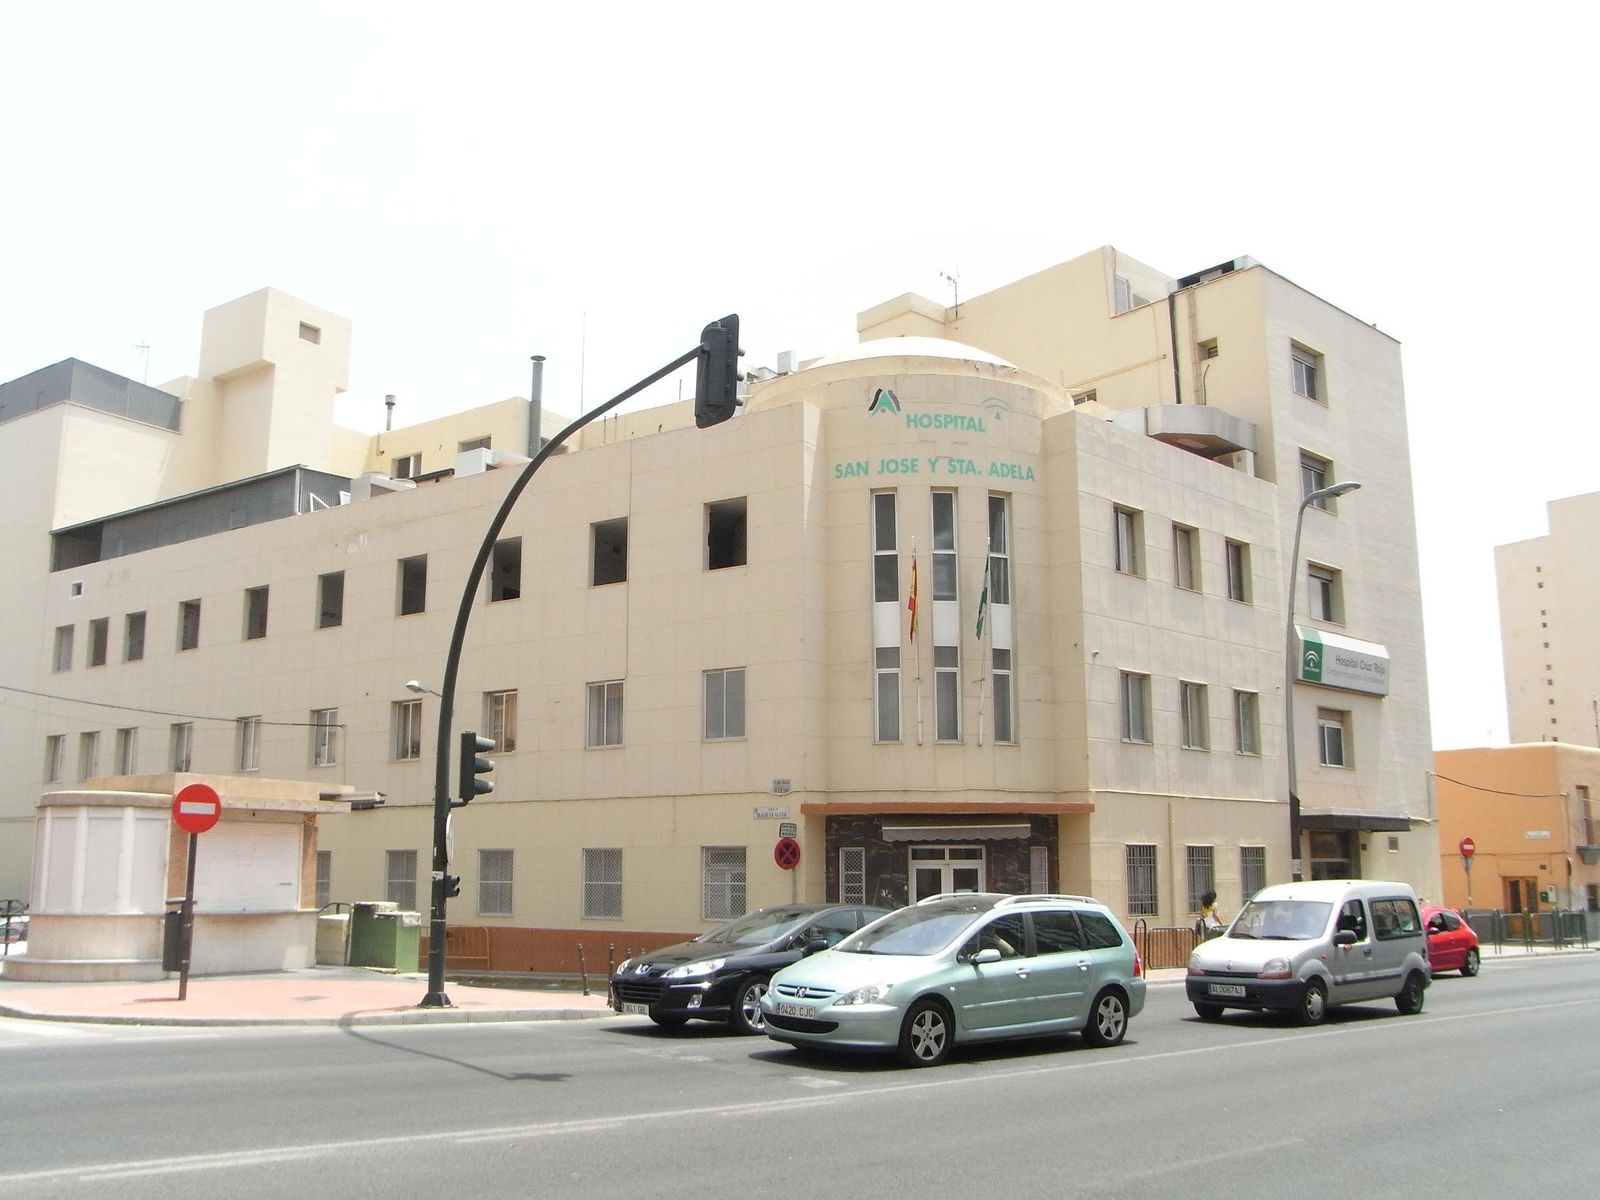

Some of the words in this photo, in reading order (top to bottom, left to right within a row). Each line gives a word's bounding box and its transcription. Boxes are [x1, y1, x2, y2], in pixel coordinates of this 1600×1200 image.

[905, 413, 986, 433] HOSPITAL
[834, 460, 869, 479] SAN
[877, 457, 919, 475] JOSE
[927, 458, 939, 474] Y
[947, 458, 982, 475] STA.
[988, 461, 1036, 481] ADELA
[1335, 655, 1358, 670] Hospital
[1360, 660, 1372, 672] Cruz
[780, 1004, 797, 1016] 0420
